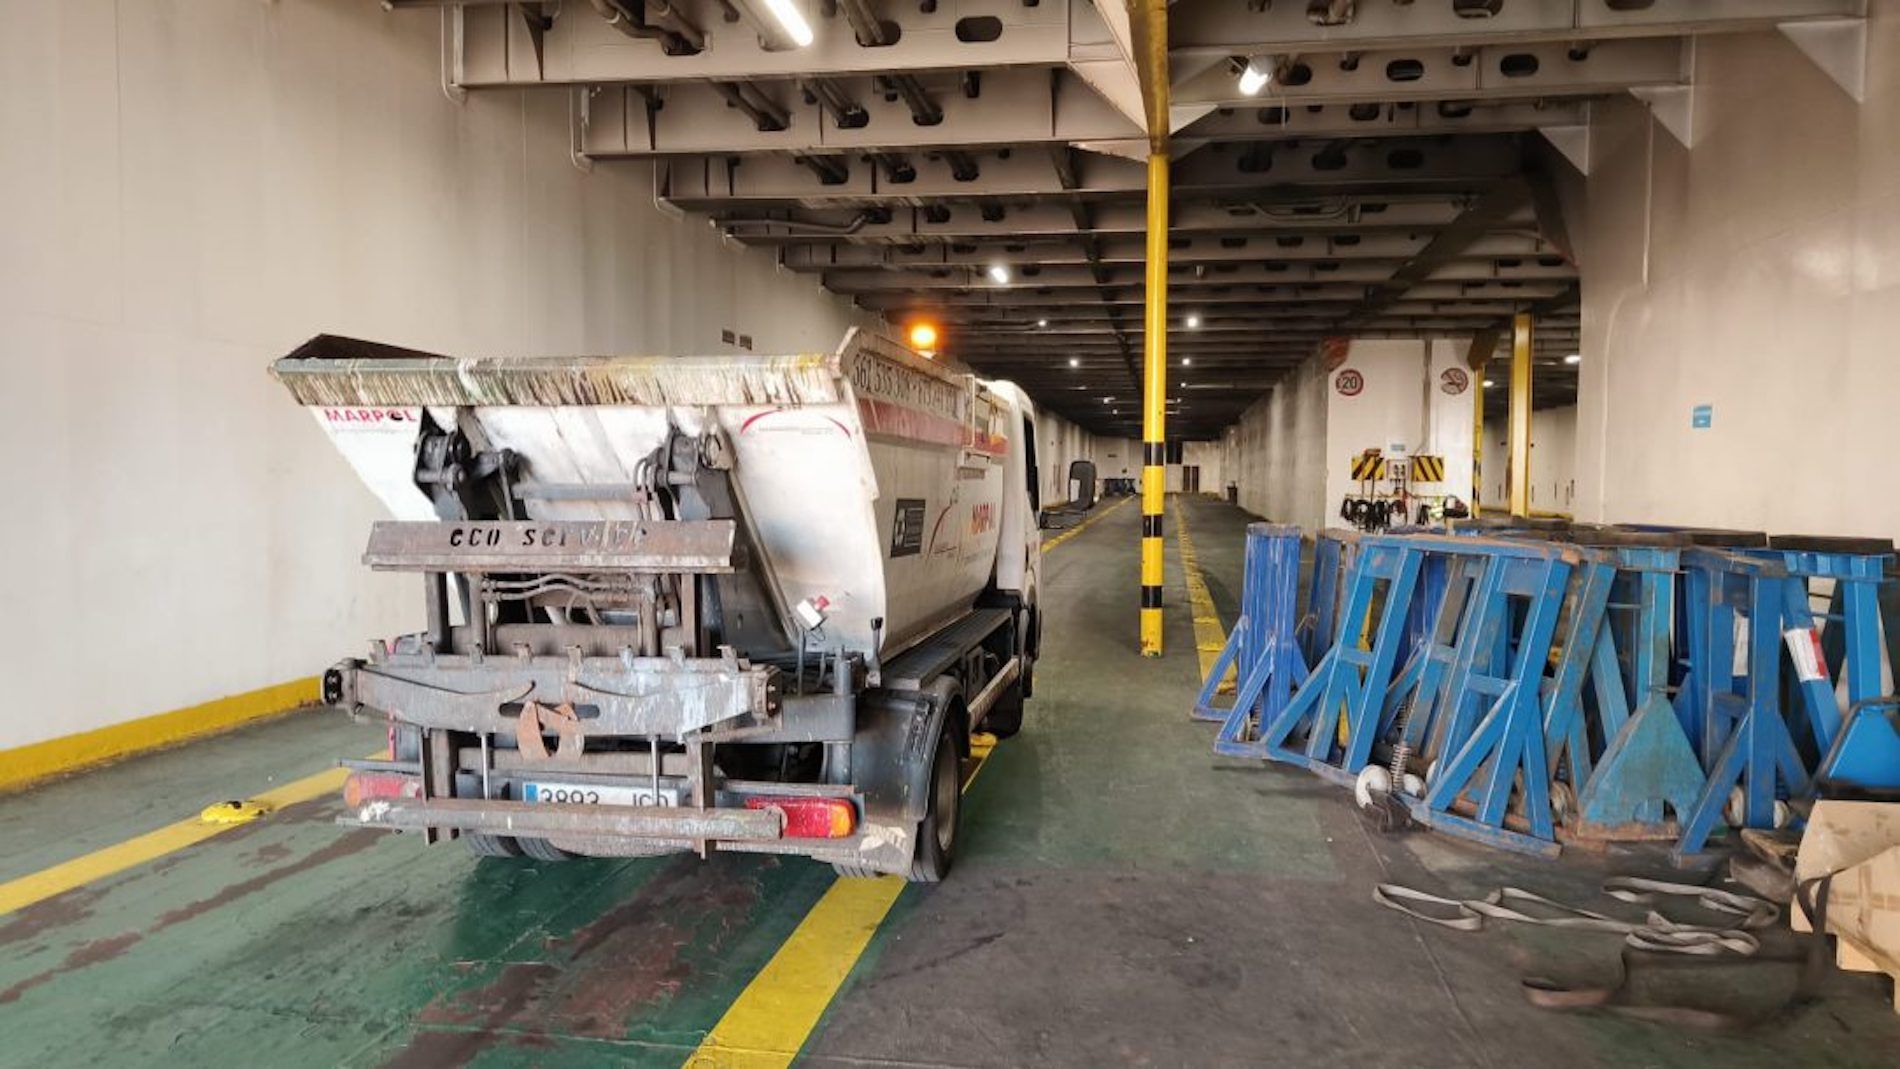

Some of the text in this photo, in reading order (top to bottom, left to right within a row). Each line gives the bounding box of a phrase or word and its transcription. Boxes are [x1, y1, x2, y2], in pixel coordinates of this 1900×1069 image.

[1342, 376, 1358, 390] 20
[325, 409, 418, 422] MARPOL
[450, 528, 501, 547] eco
